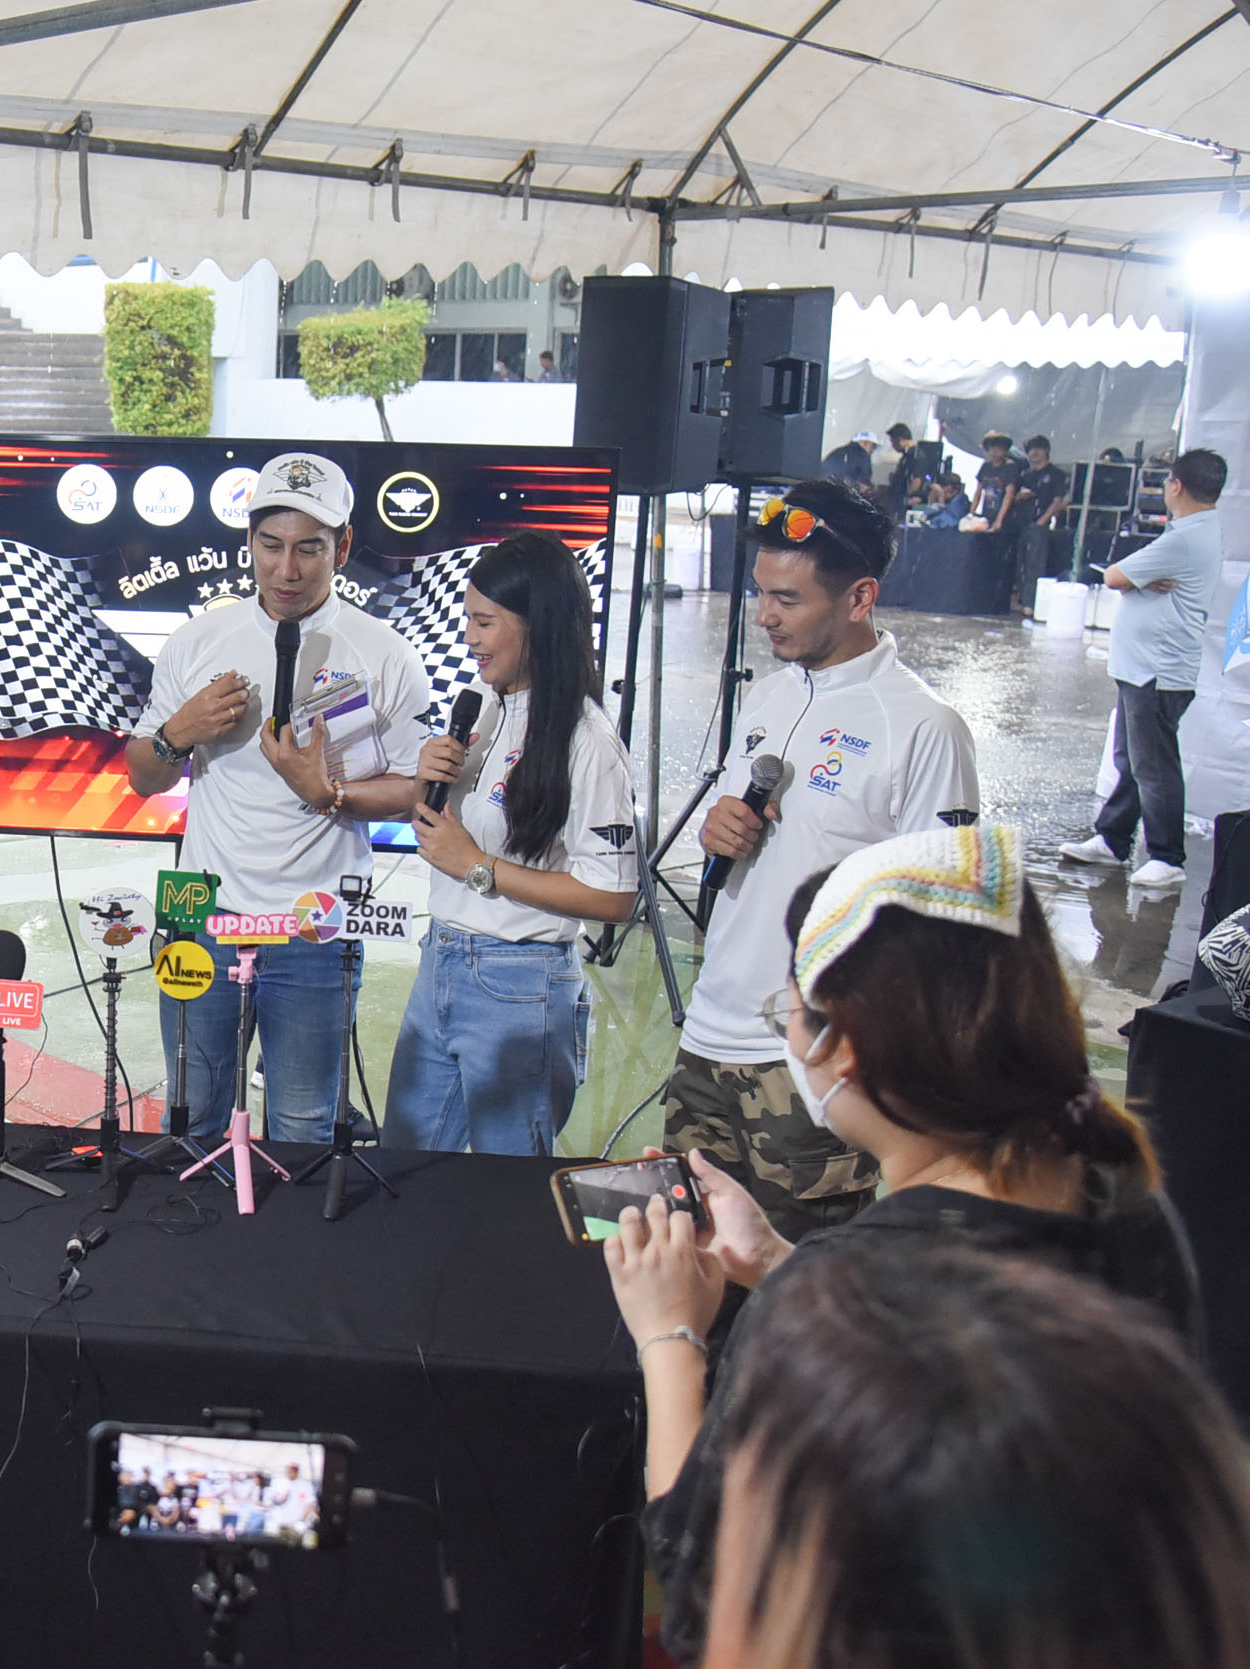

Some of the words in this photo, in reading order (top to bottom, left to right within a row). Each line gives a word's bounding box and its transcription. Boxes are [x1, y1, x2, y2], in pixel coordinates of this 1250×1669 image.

[222, 508, 250, 518] NSD
[186, 547, 228, 573] แว้น
[840, 733, 871, 751] NSDF
[809, 775, 842, 792] SAT
[162, 880, 210, 915] MP
[347, 902, 407, 920] ZOOM
[207, 915, 298, 935] UPDATE
[346, 919, 406, 937] DARA
[2, 1016, 22, 1026] LIVE
